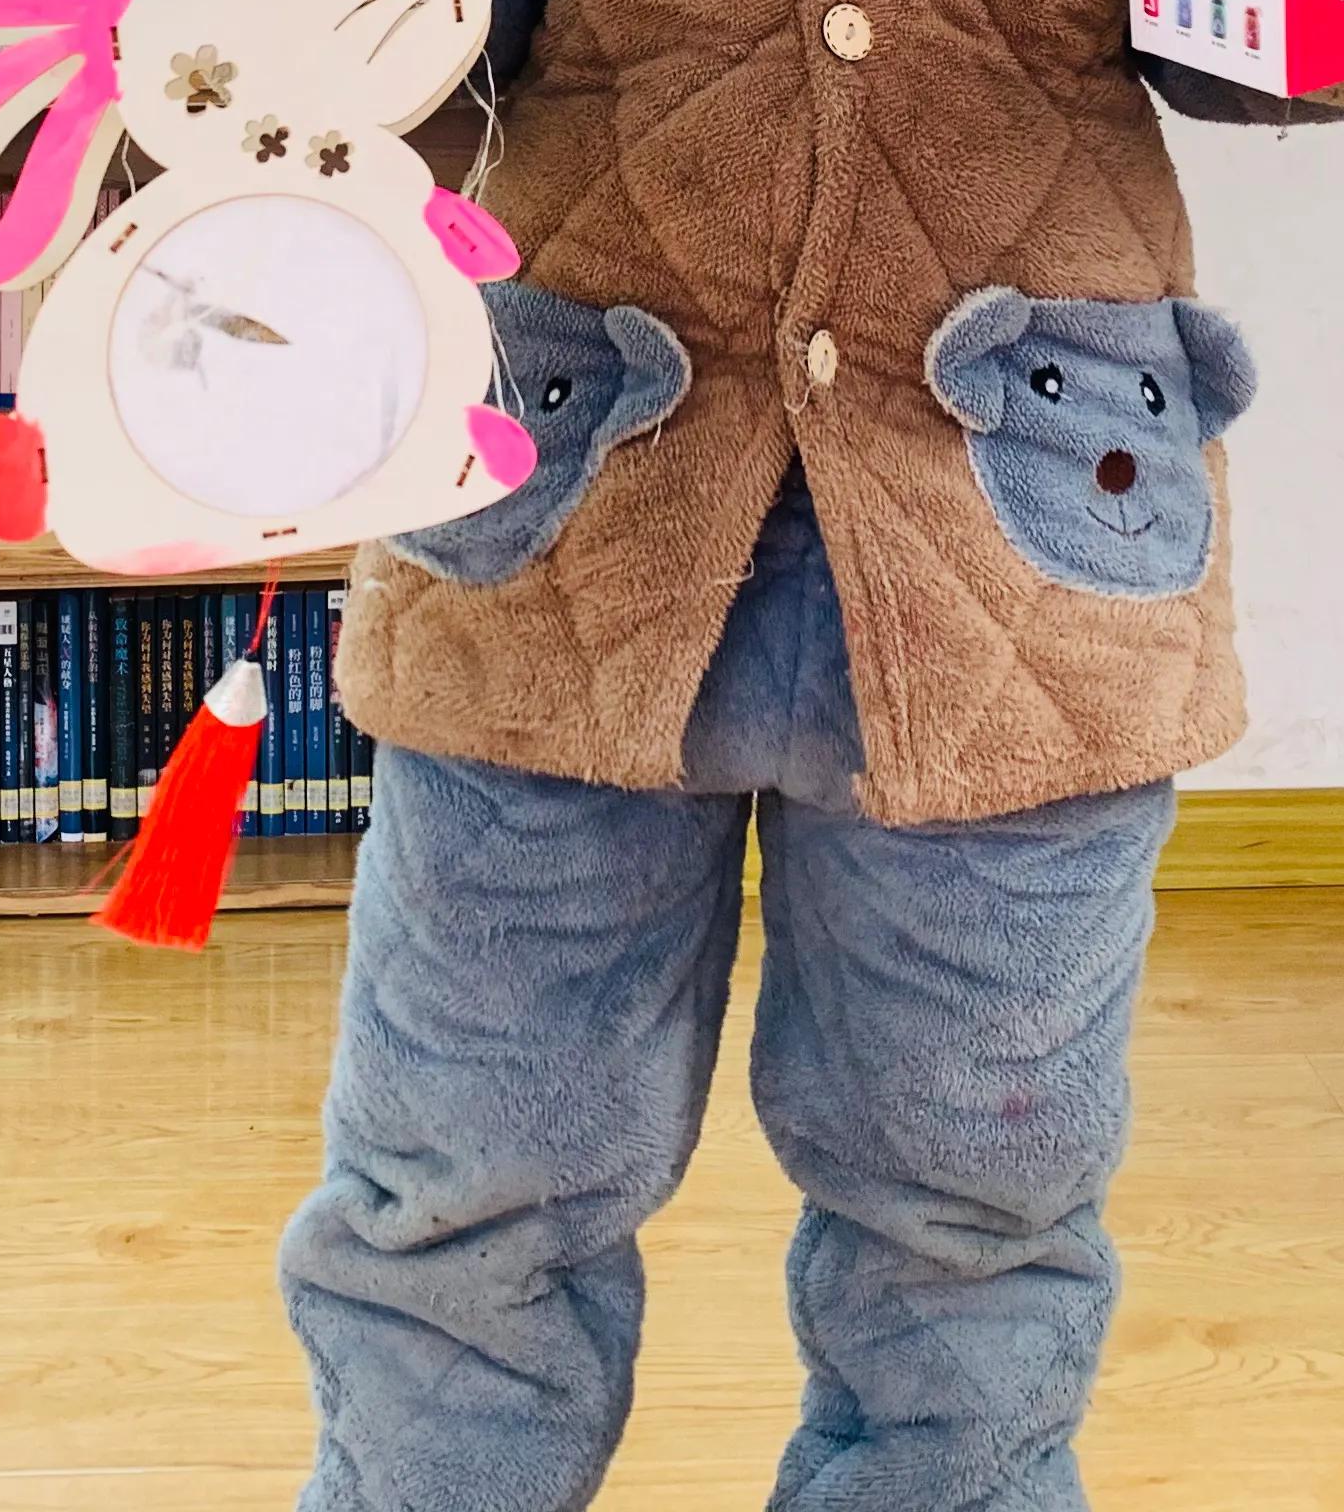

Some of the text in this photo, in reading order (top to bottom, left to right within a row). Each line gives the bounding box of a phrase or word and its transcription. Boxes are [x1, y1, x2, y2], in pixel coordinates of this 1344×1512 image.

[115, 618, 128, 676] 致命魔术
[309, 646, 323, 711] 粉红色的脚
[288, 648, 302, 714] 粉红色的脚
